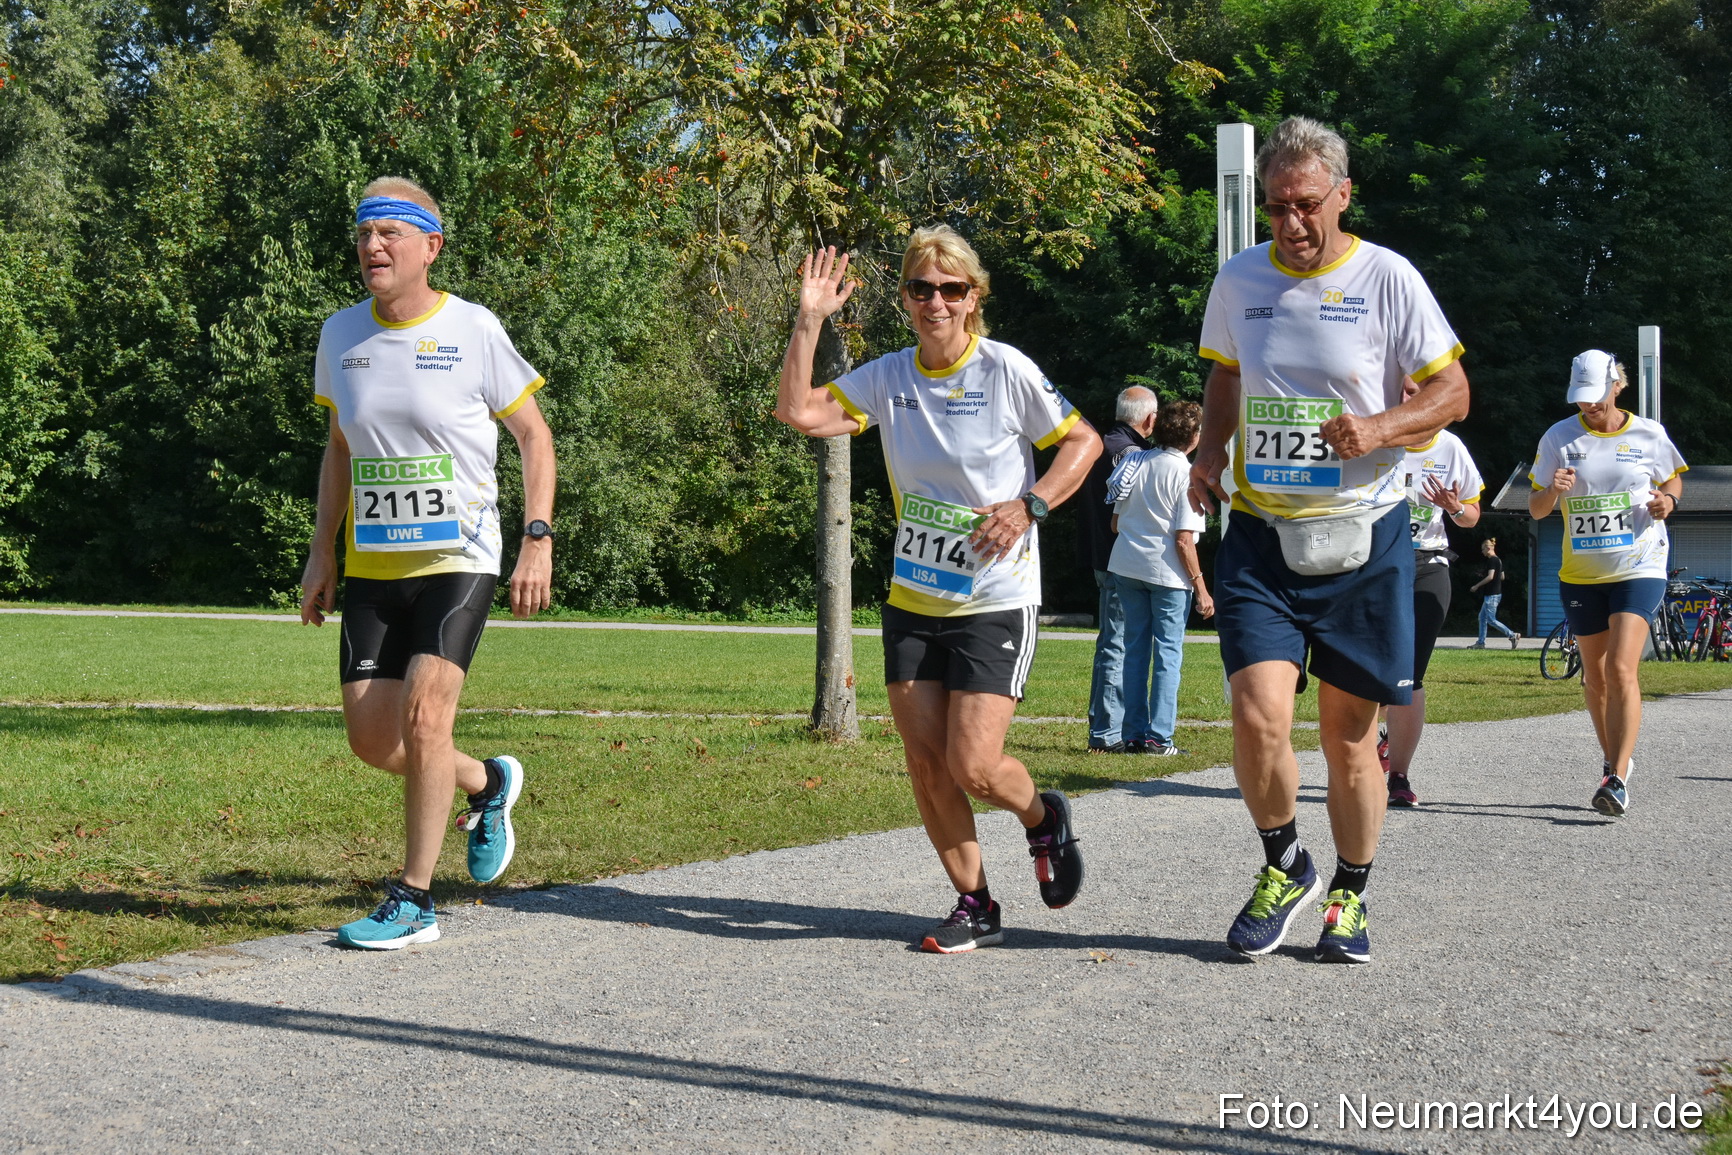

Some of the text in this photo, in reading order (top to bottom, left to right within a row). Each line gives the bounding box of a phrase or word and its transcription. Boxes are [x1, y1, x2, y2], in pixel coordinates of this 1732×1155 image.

[1322, 290, 1343, 303] 20
[1245, 307, 1273, 317] BOCK
[1320, 304, 1369, 315] Neumarkter
[1319, 314, 1359, 324] Stadtlauf
[417, 340, 437, 352] 20
[342, 358, 370, 367] BOCK
[416, 354, 463, 363] Neumarkter
[415, 363, 453, 372] Stadtlauf
[946, 387, 965, 399] 20
[946, 400, 988, 408] Neumarkter
[945, 408, 979, 417] Stadtlauf
[1252, 400, 1333, 422] BOCK
[1254, 430, 1329, 461] 2123
[1617, 444, 1629, 453] 20
[1422, 459, 1434, 468] 20
[359, 458, 446, 482] BOCK
[1263, 468, 1312, 483] PETER
[364, 488, 445, 519] 2113
[1571, 495, 1626, 511] BOCK
[905, 497, 975, 532] BOCK
[1575, 513, 1624, 534] 2121
[387, 527, 424, 541] UWE
[901, 526, 966, 569] 2114
[1580, 536, 1623, 548] CLAUDIA
[912, 566, 938, 586] LISA
